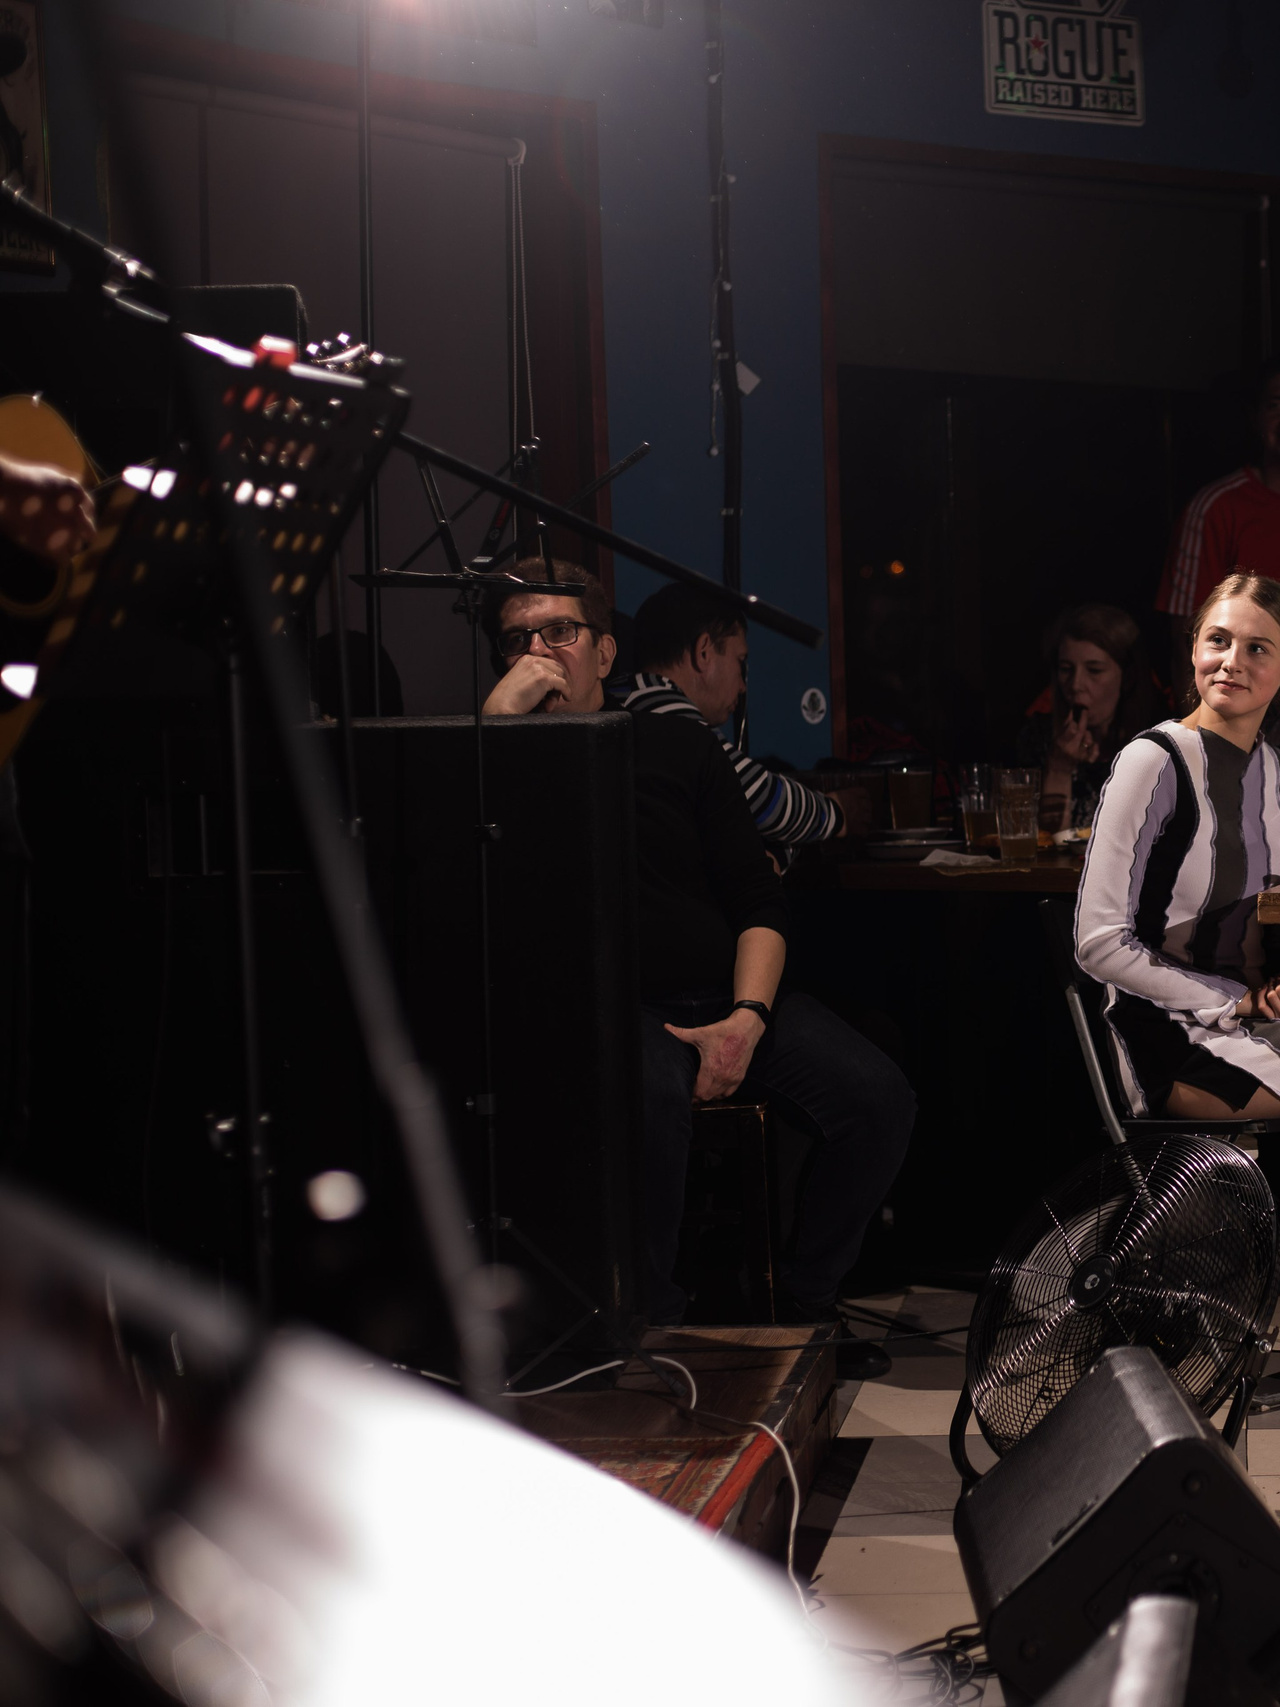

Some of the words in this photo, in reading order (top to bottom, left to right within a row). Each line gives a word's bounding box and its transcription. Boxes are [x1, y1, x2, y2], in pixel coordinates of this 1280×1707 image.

[993, 9, 1135, 85] ROGUE
[997, 79, 1073, 107] RAISED
[1080, 87, 1134, 111] HERE
